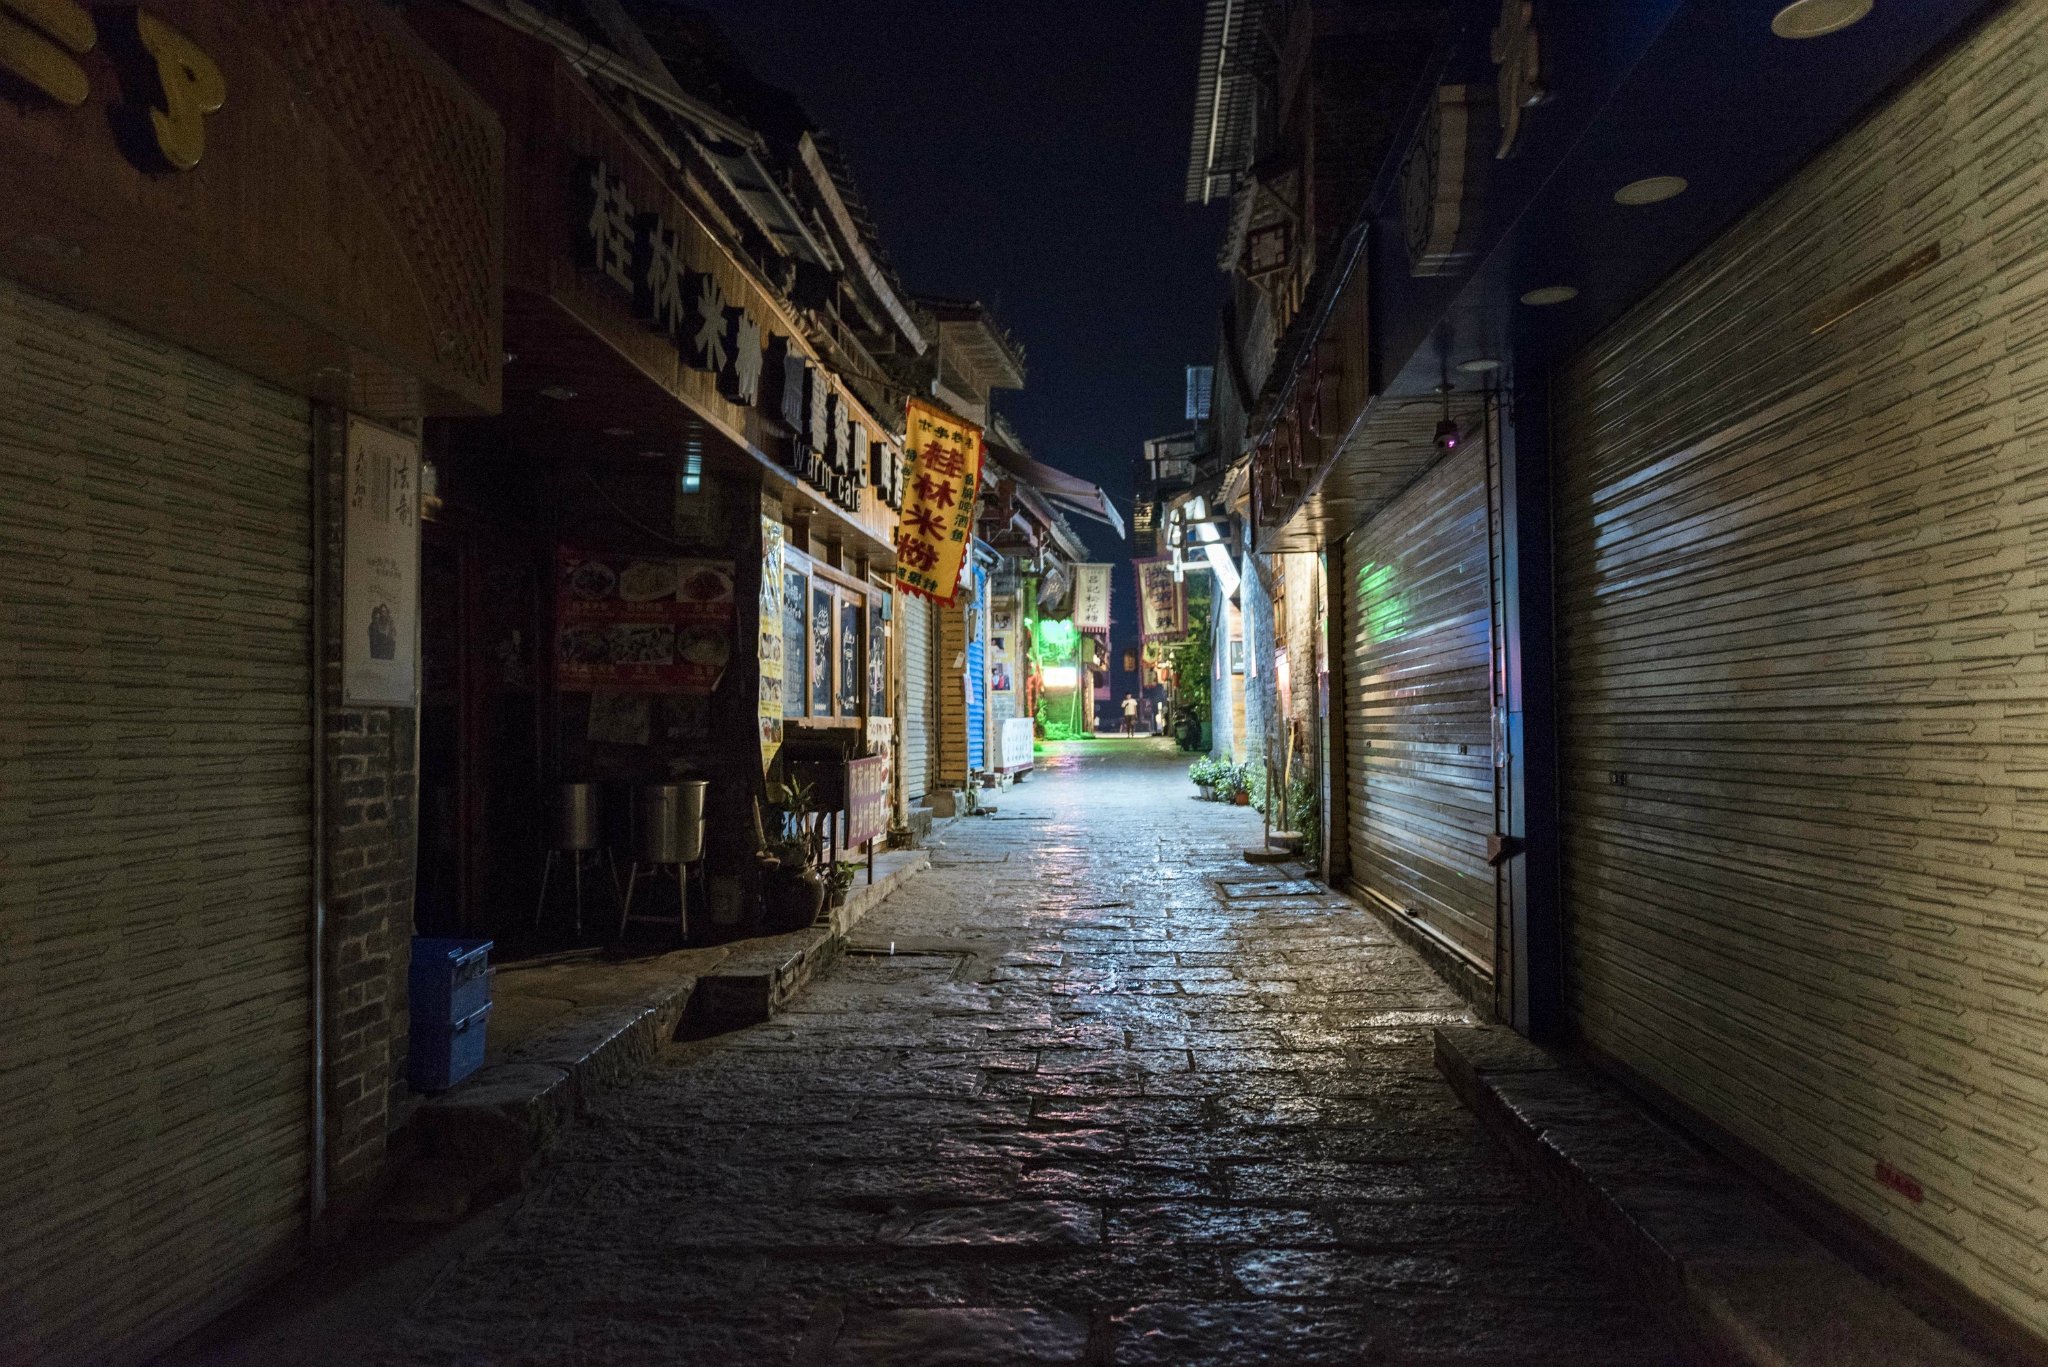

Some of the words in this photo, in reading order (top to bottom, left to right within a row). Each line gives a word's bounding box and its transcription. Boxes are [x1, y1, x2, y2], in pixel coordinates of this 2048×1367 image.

[588, 161, 763, 407] 桂林米粉
[897, 440, 965, 571] 桂林米粉
